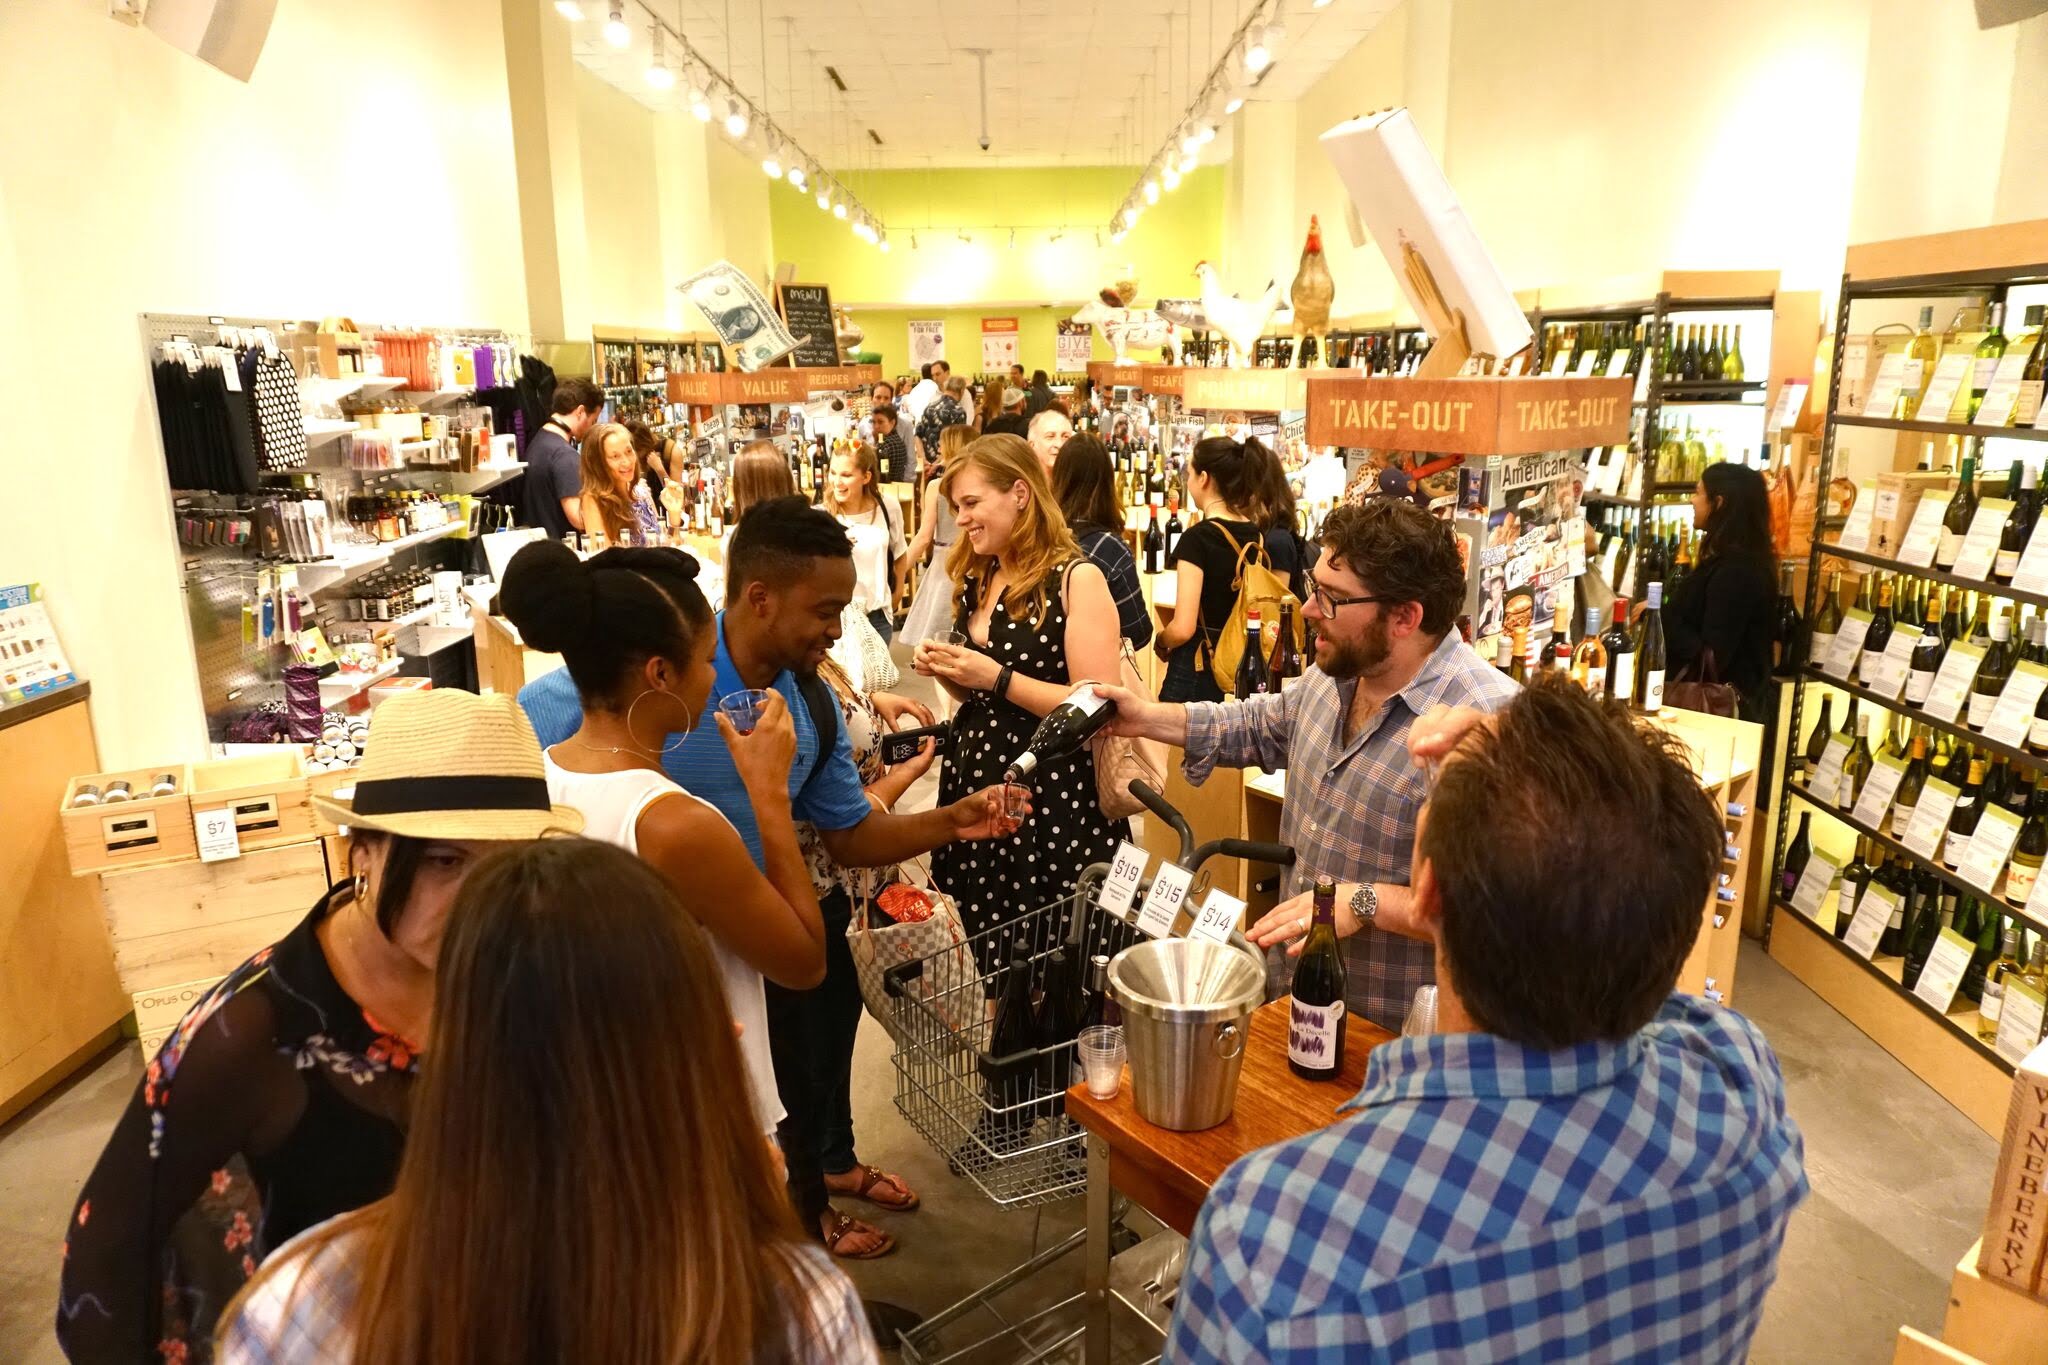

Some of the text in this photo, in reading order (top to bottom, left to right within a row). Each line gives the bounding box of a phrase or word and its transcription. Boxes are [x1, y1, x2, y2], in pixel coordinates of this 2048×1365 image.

[790, 289, 822, 302] MENU
[1058, 336, 1091, 348] GIVE
[809, 373, 849, 385] RECIPES
[1114, 370, 1138, 381] MEAT
[679, 380, 708, 396] VALUE
[742, 380, 789, 396] VALUE
[1171, 416, 1204, 426] Light Fish
[1329, 399, 1473, 432] TAKE-OUT
[1517, 397, 1618, 432] TAKE-OUT
[703, 418, 720, 433] Cheap
[1286, 420, 1306, 440] Chic
[1502, 457, 1567, 488] American
[208, 820, 226, 837] $7
[1114, 856, 1139, 882] $19
[1155, 876, 1182, 904] $15
[1202, 903, 1232, 932] $14
[2001, 1085, 2048, 1277] VINEBERRY
